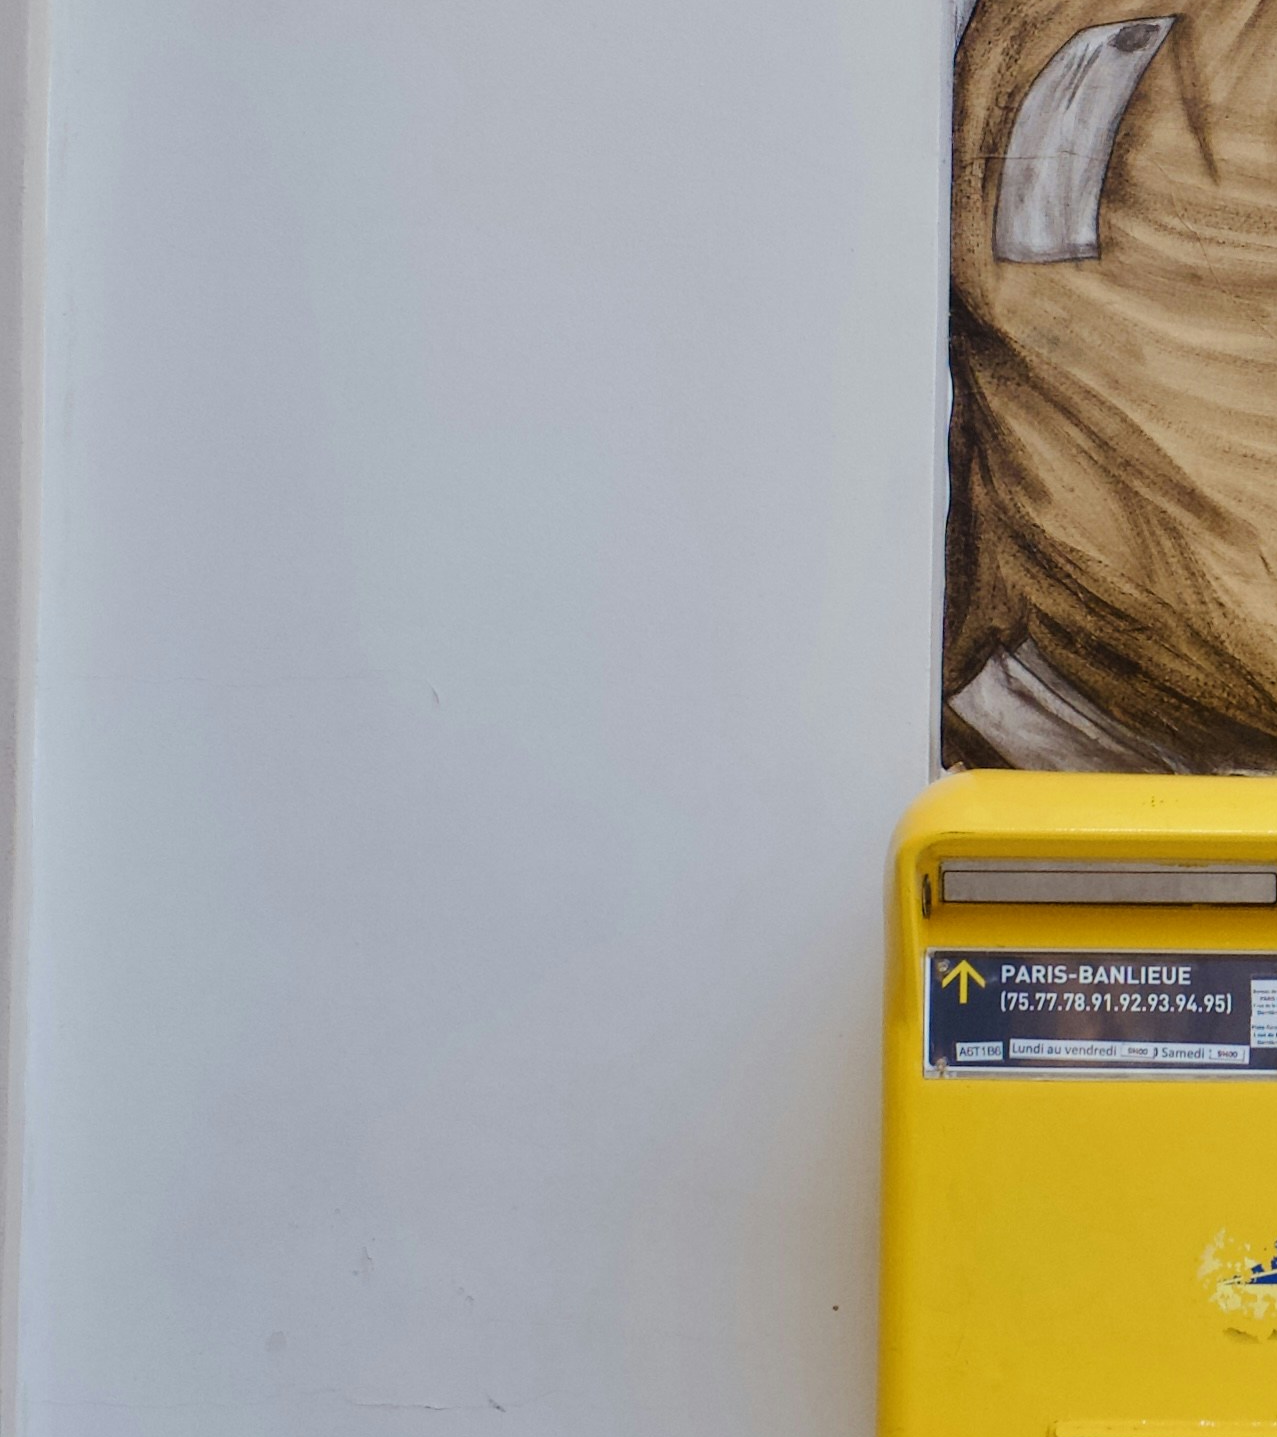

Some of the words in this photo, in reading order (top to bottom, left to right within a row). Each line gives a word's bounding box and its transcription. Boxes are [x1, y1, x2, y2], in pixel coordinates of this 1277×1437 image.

[1000, 964, 1191, 985] PARIS-BANLIEUE
[1000, 992, 1232, 1014] (75.77.78.91.92.93.94.95)
[1012, 1042, 1044, 1054] Lundi
[1047, 1046, 1061, 1055] au
[1065, 1044, 1117, 1056] vendredi
[1161, 1047, 1205, 1059] Samedi
